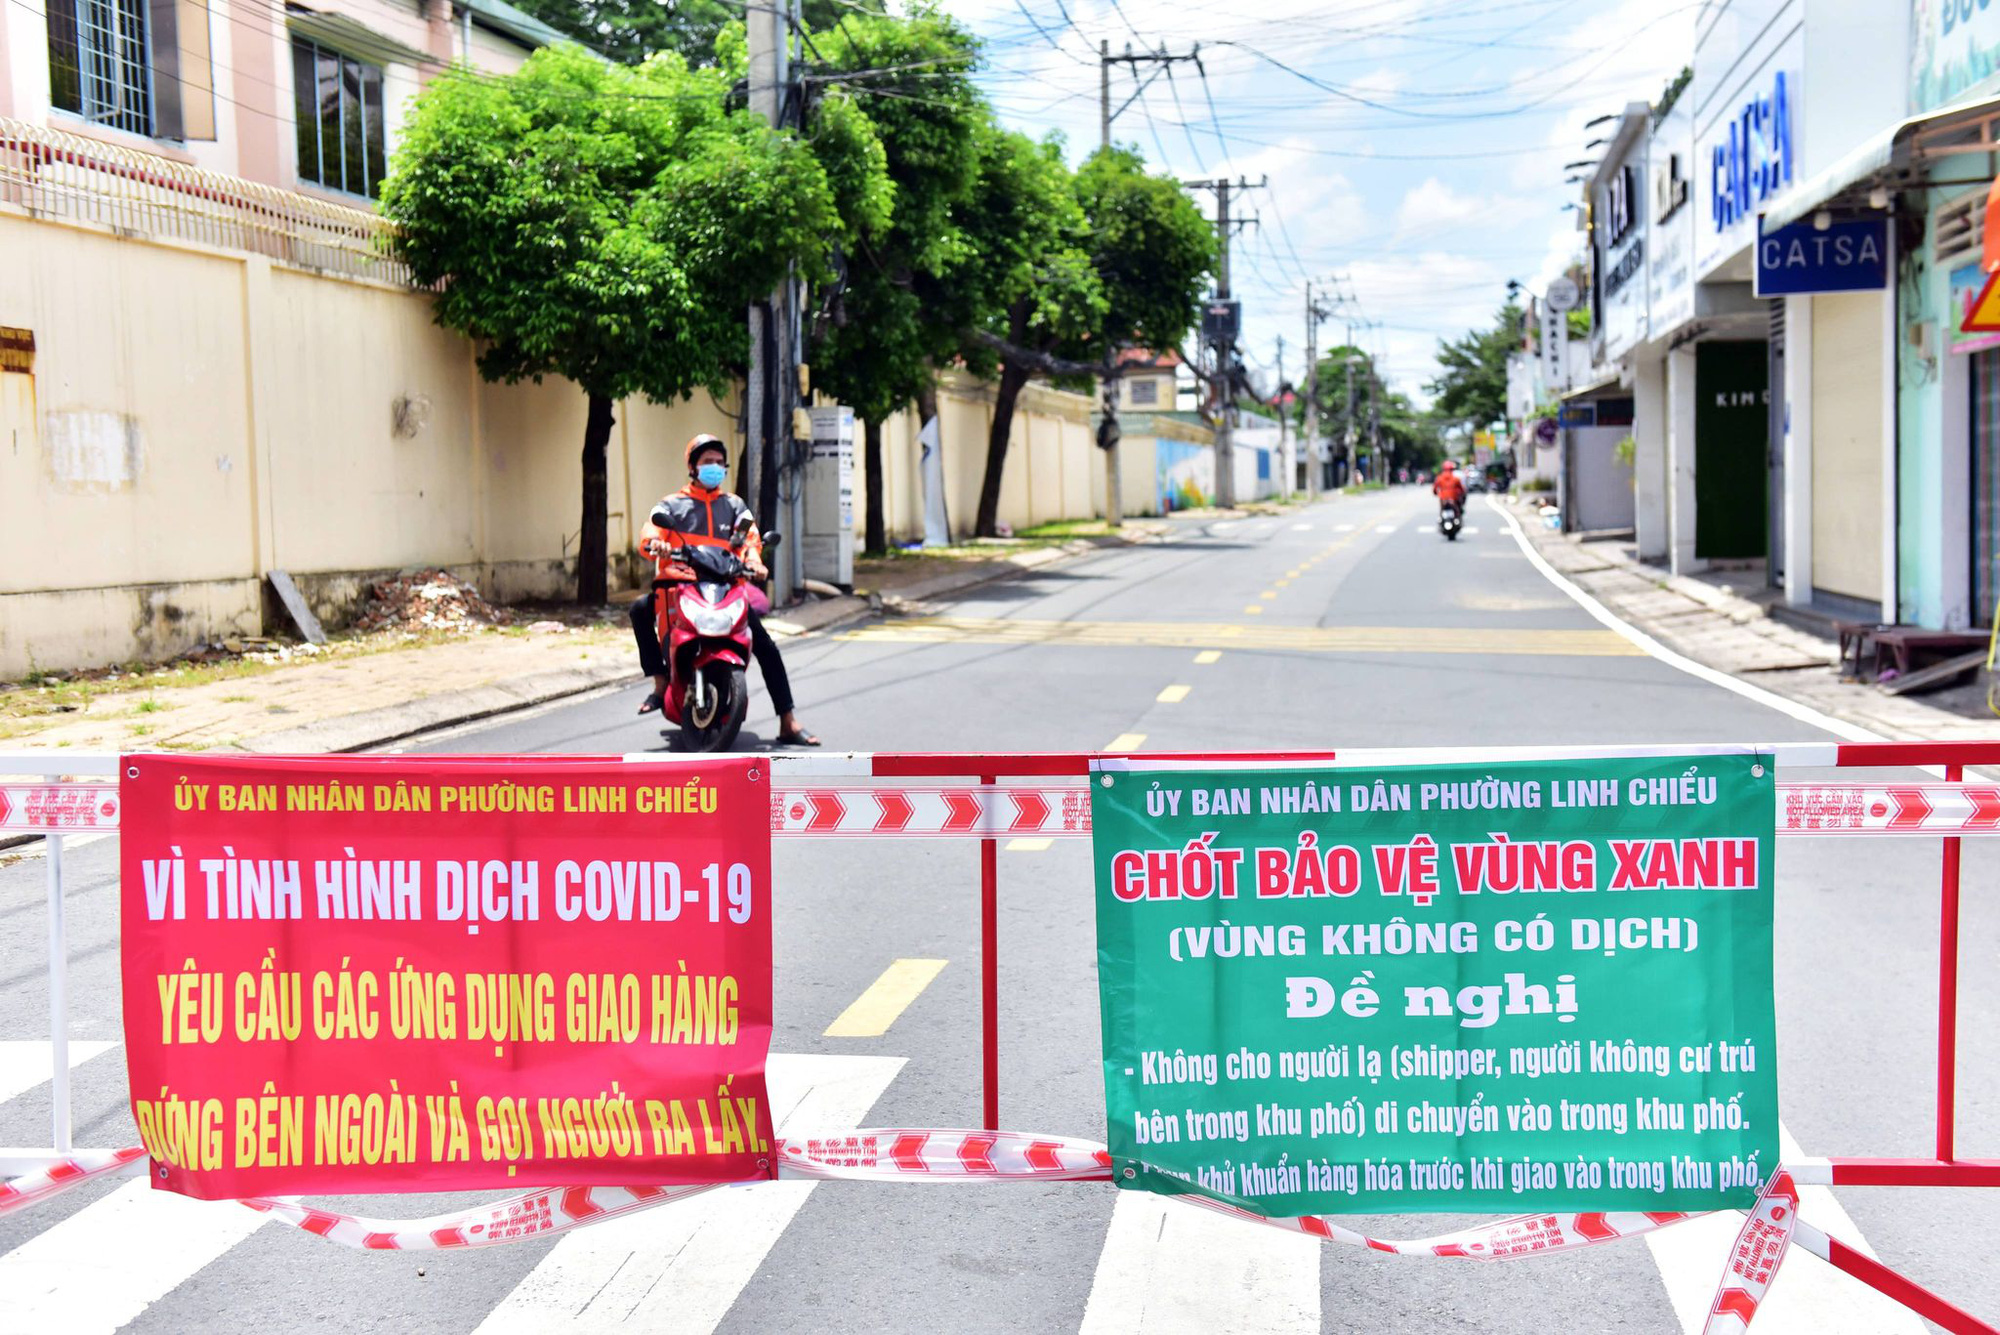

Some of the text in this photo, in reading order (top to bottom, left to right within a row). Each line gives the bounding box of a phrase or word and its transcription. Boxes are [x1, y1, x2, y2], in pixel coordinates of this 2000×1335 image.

[1712, 71, 1792, 234] CATSA
[1762, 233, 1879, 270] CATSA
[175, 776, 717, 813] ỦY BAN NHÂN DÂN PHƯỜNG LINH CHIỂU
[1146, 766, 1716, 817] ỦY BAN NHÂN DÂN PHƯỜNG LINH CHIỂU
[142, 846, 751, 934] VÌ TÌNH HÌNH DỊCH COVID-19
[1112, 830, 1758, 906] CHỐT BẢO VỆ VÙNG XANH
[1170, 913, 1697, 961] (VÙNG KHÔNG CÓ DỊCH)
[158, 948, 738, 1057] YÊU CẦU CÁC ỨNG DỤNG GIAO HÀNG
[1286, 971, 1578, 1028] Đề nghị
[1142, 1049, 1217, 1085] Không
[1226, 1047, 1270, 1080] cho
[1280, 1045, 1348, 1081] người
[1359, 1045, 1381, 1083] lạ
[1391, 1045, 1501, 1079] (shipper,
[1510, 1040, 1580, 1078] người
[1590, 1039, 1670, 1076] không
[1680, 1043, 1712, 1072] cư
[1719, 1039, 1755, 1072] trú
[235, 1081, 303, 1168] BÊN
[315, 1079, 417, 1165] NGOÀI
[426, 1080, 469, 1162] VÀ
[476, 1096, 533, 1176] GỌI
[538, 1081, 643, 1158] NGƯỜI
[647, 1100, 695, 1155] RA
[698, 1074, 768, 1154] LẤY.
[1135, 1092, 1749, 1144] bên trong khu phố) di chuyển vào trong khu phố.
[1197, 1160, 1235, 1196] khử
[1241, 1153, 1300, 1196] khuẩn
[1307, 1159, 1357, 1195] hàng
[1365, 1158, 1402, 1190] hóa
[1410, 1156, 1463, 1190] trước
[1471, 1157, 1503, 1189] khi
[1512, 1157, 1556, 1193] giao
[1564, 1155, 1601, 1188] vào
[1609, 1157, 1664, 1192] trong
[1672, 1156, 1712, 1188] khu
